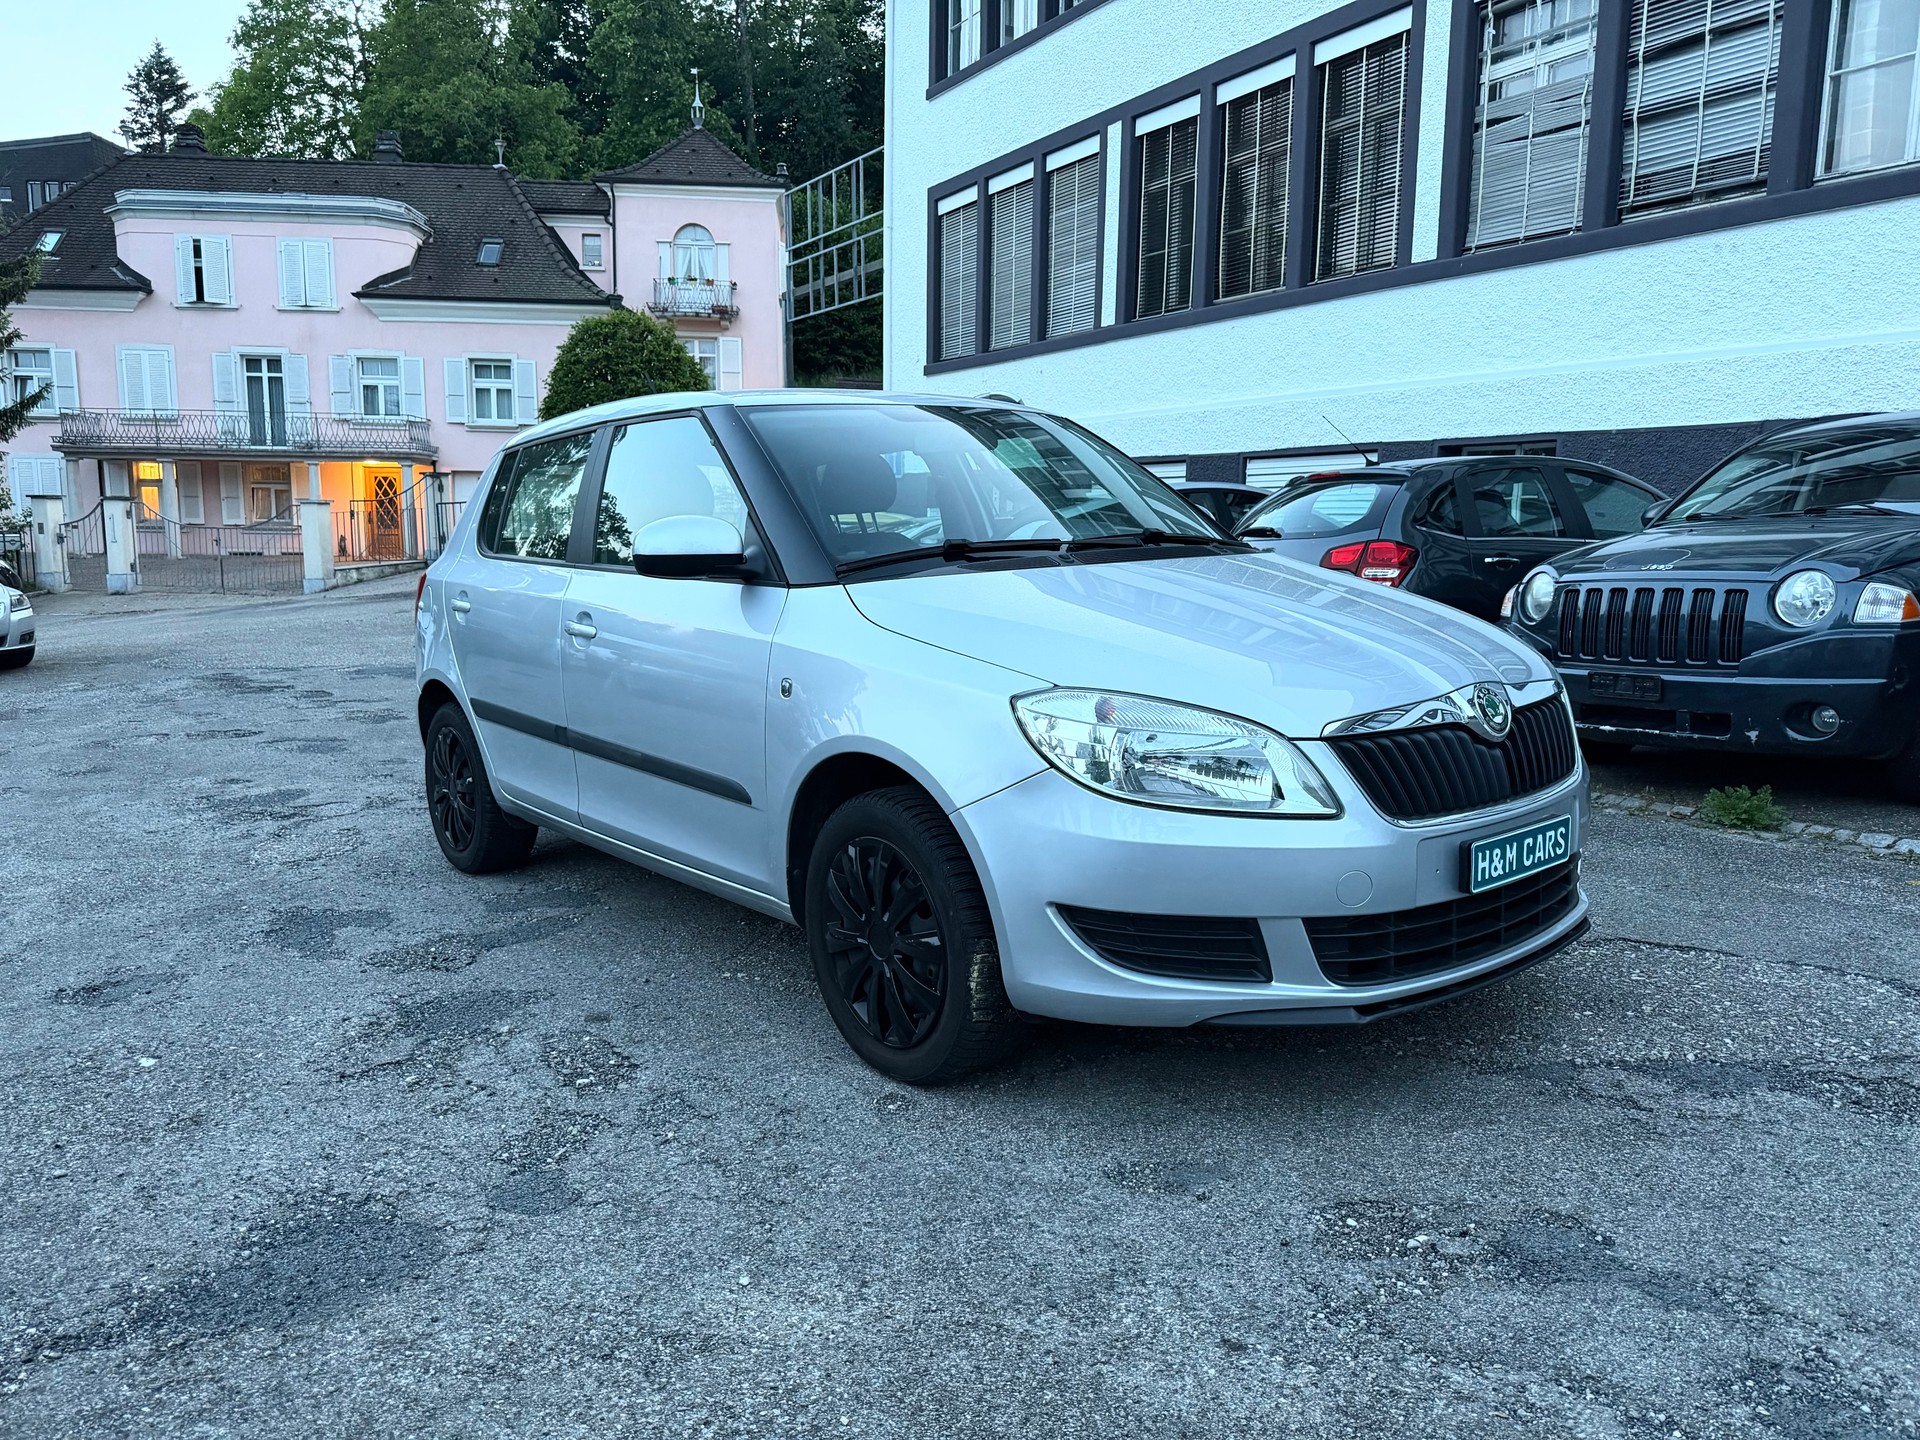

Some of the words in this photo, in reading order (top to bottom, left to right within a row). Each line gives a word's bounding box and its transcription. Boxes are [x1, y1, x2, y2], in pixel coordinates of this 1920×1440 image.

[1640, 563, 1674, 571] Jeep
[1478, 842, 1517, 882] H&M
[1523, 827, 1566, 867] CARS
